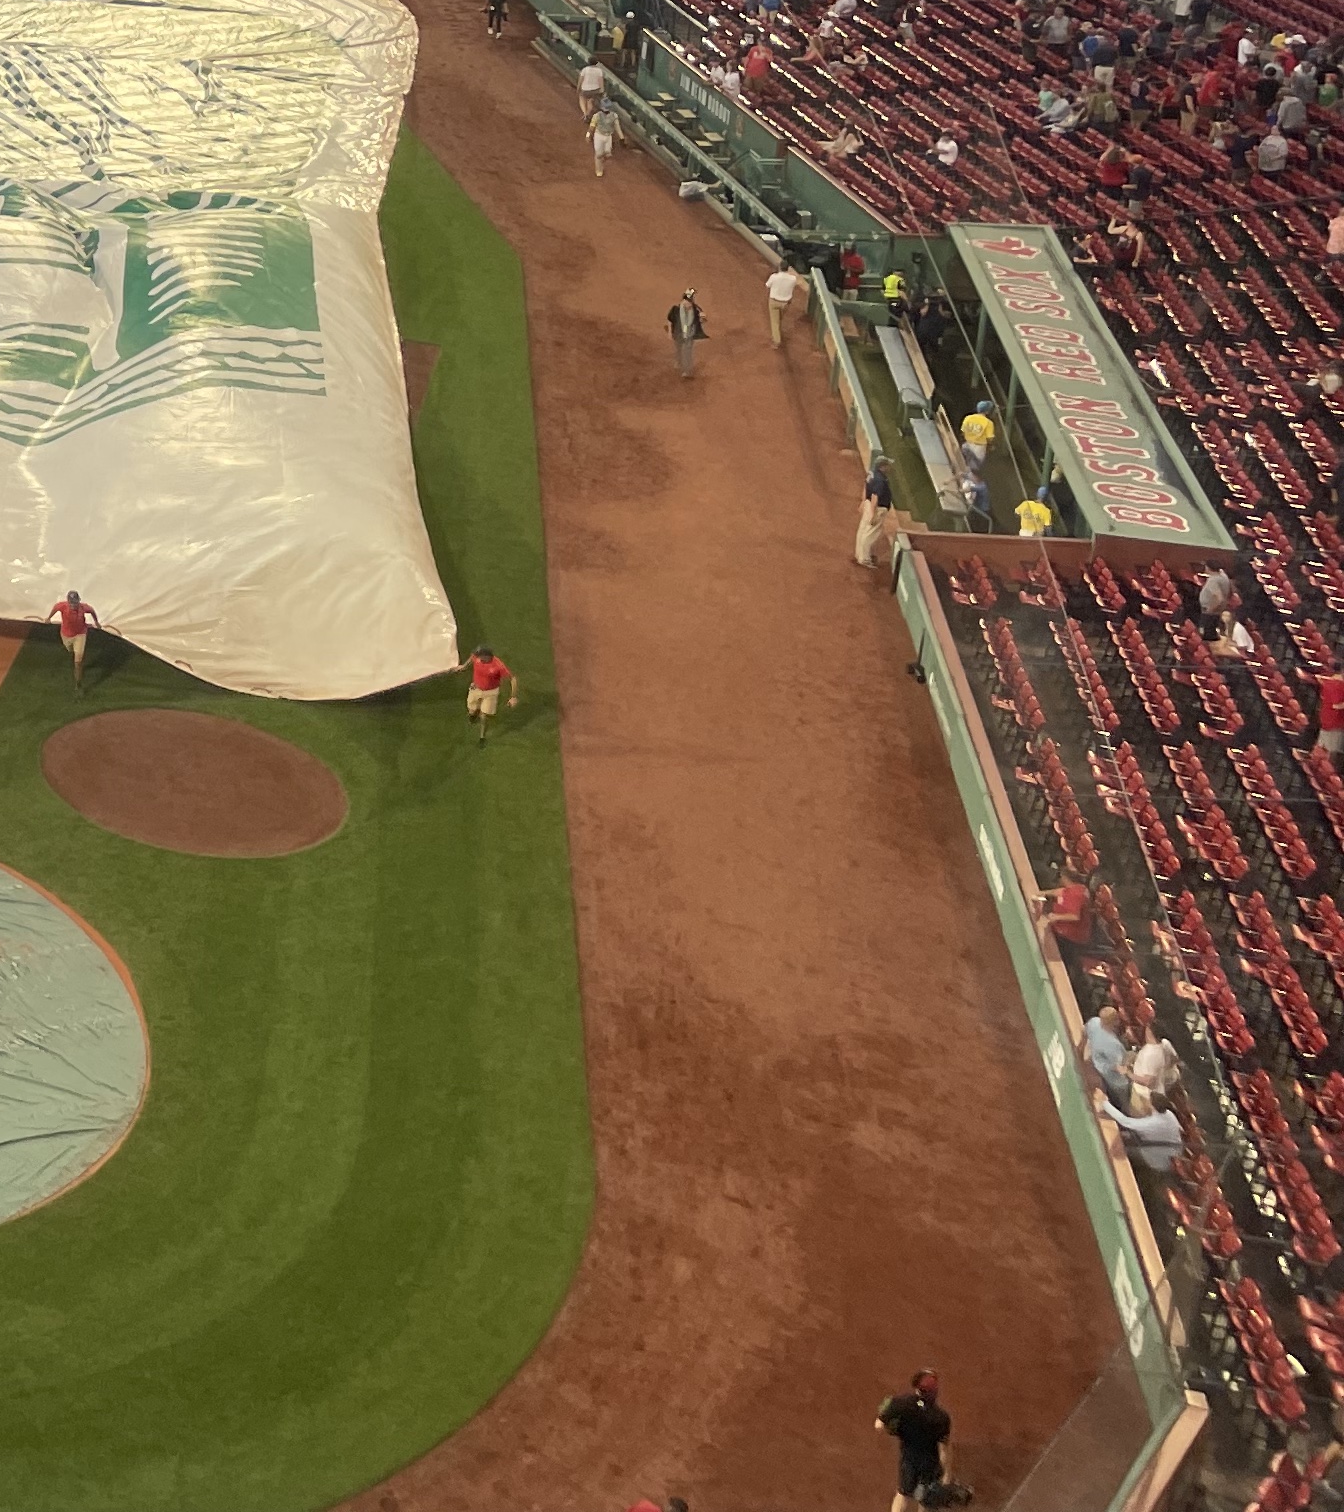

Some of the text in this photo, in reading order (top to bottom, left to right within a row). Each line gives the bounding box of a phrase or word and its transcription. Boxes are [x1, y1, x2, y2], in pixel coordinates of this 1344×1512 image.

[985, 261, 1191, 533] BOSTON RED SOX
